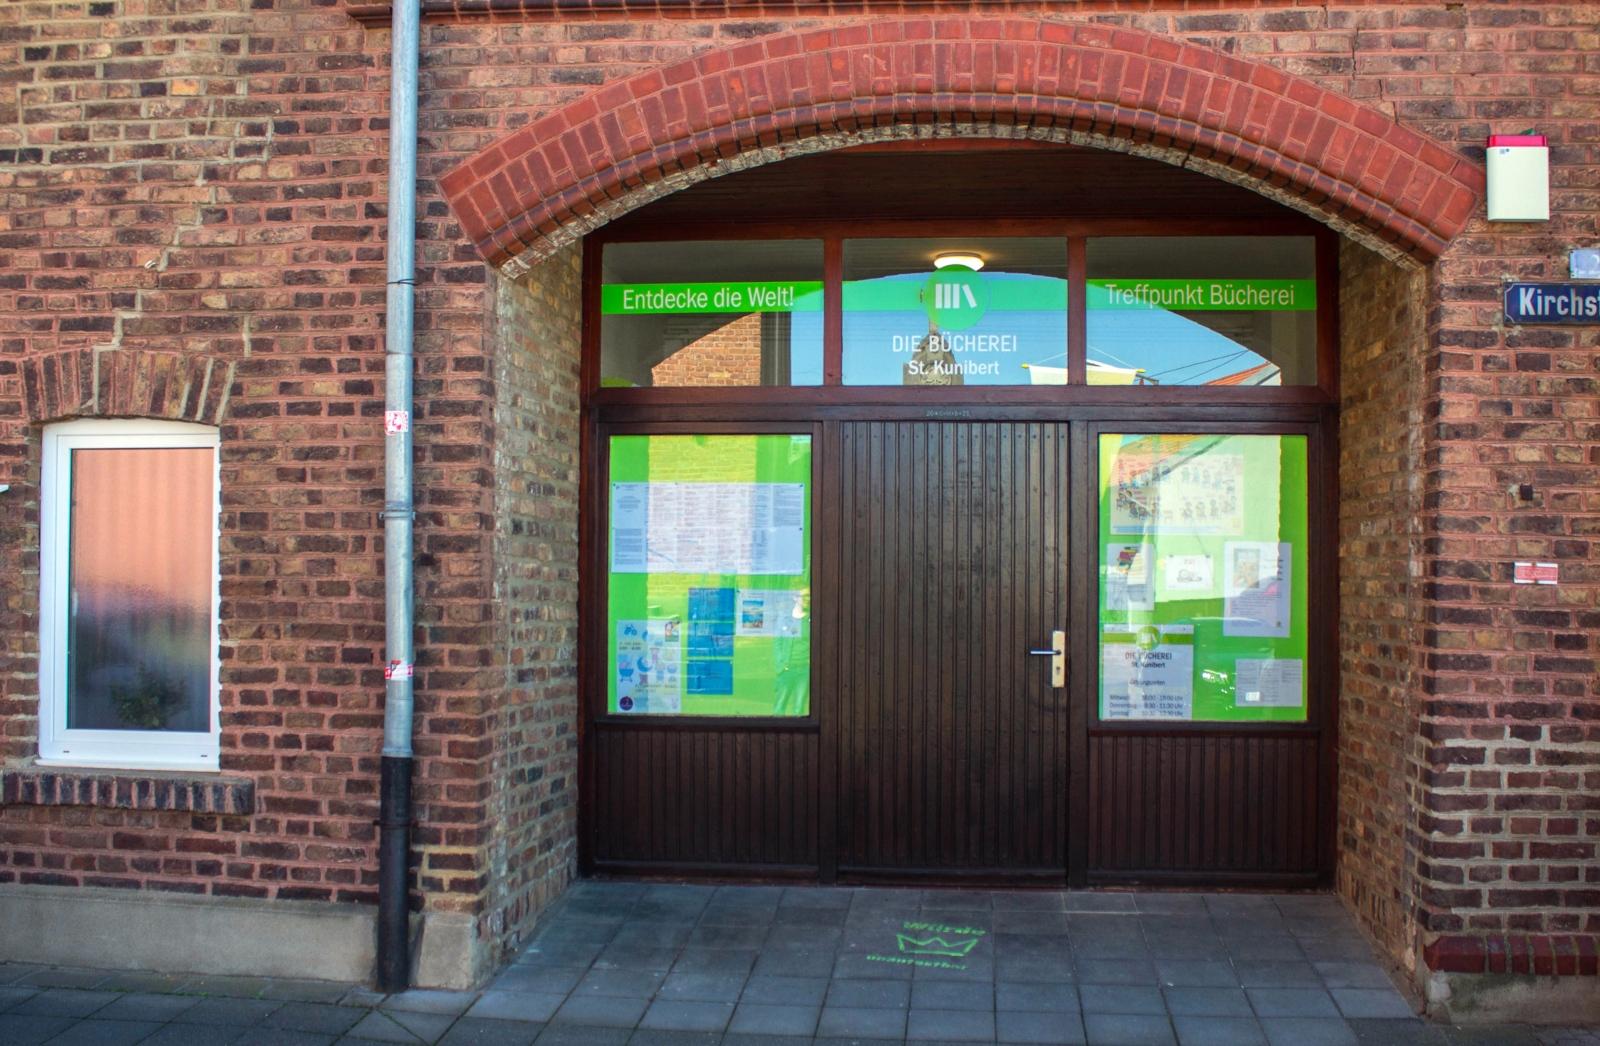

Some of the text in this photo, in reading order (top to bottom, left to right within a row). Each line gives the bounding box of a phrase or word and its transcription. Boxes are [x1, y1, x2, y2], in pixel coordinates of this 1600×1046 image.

[623, 286, 795, 310] Entdecke die Welt!
[1105, 284, 1295, 309] Treffpunkt Bücherei
[1519, 287, 1600, 317] Kirchs
[892, 332, 1017, 352] DIE BÜCHEREI
[908, 359, 1000, 375] St. Kunibert
